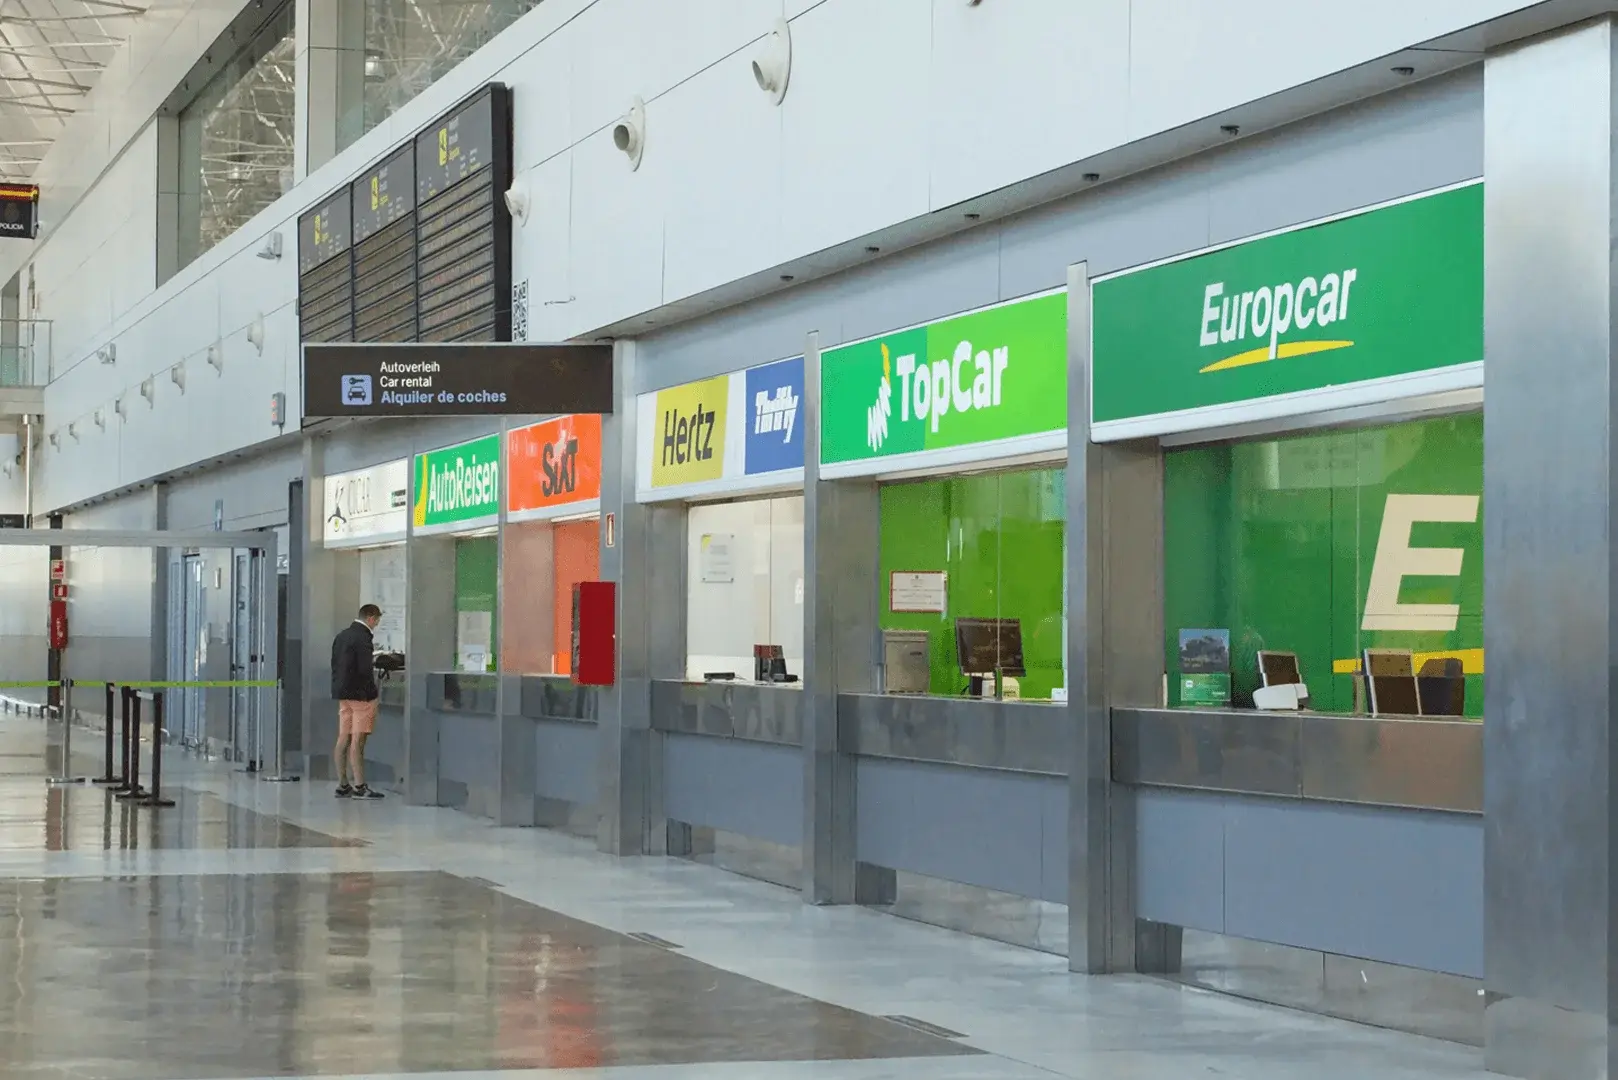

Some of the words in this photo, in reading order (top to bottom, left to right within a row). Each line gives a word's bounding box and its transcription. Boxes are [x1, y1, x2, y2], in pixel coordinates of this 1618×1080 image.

[1199, 267, 1358, 360] Europcar
[380, 361, 441, 373] Autoverleih
[380, 375, 399, 388] Car
[401, 375, 433, 388] rental
[381, 390, 435, 406] Alquiler
[437, 390, 455, 403] de
[457, 390, 507, 403] coches
[896, 340, 1009, 433] TopCar
[662, 402, 715, 467] Hertz
[428, 454, 500, 514] AutoReisen
[1361, 494, 1480, 631] E
